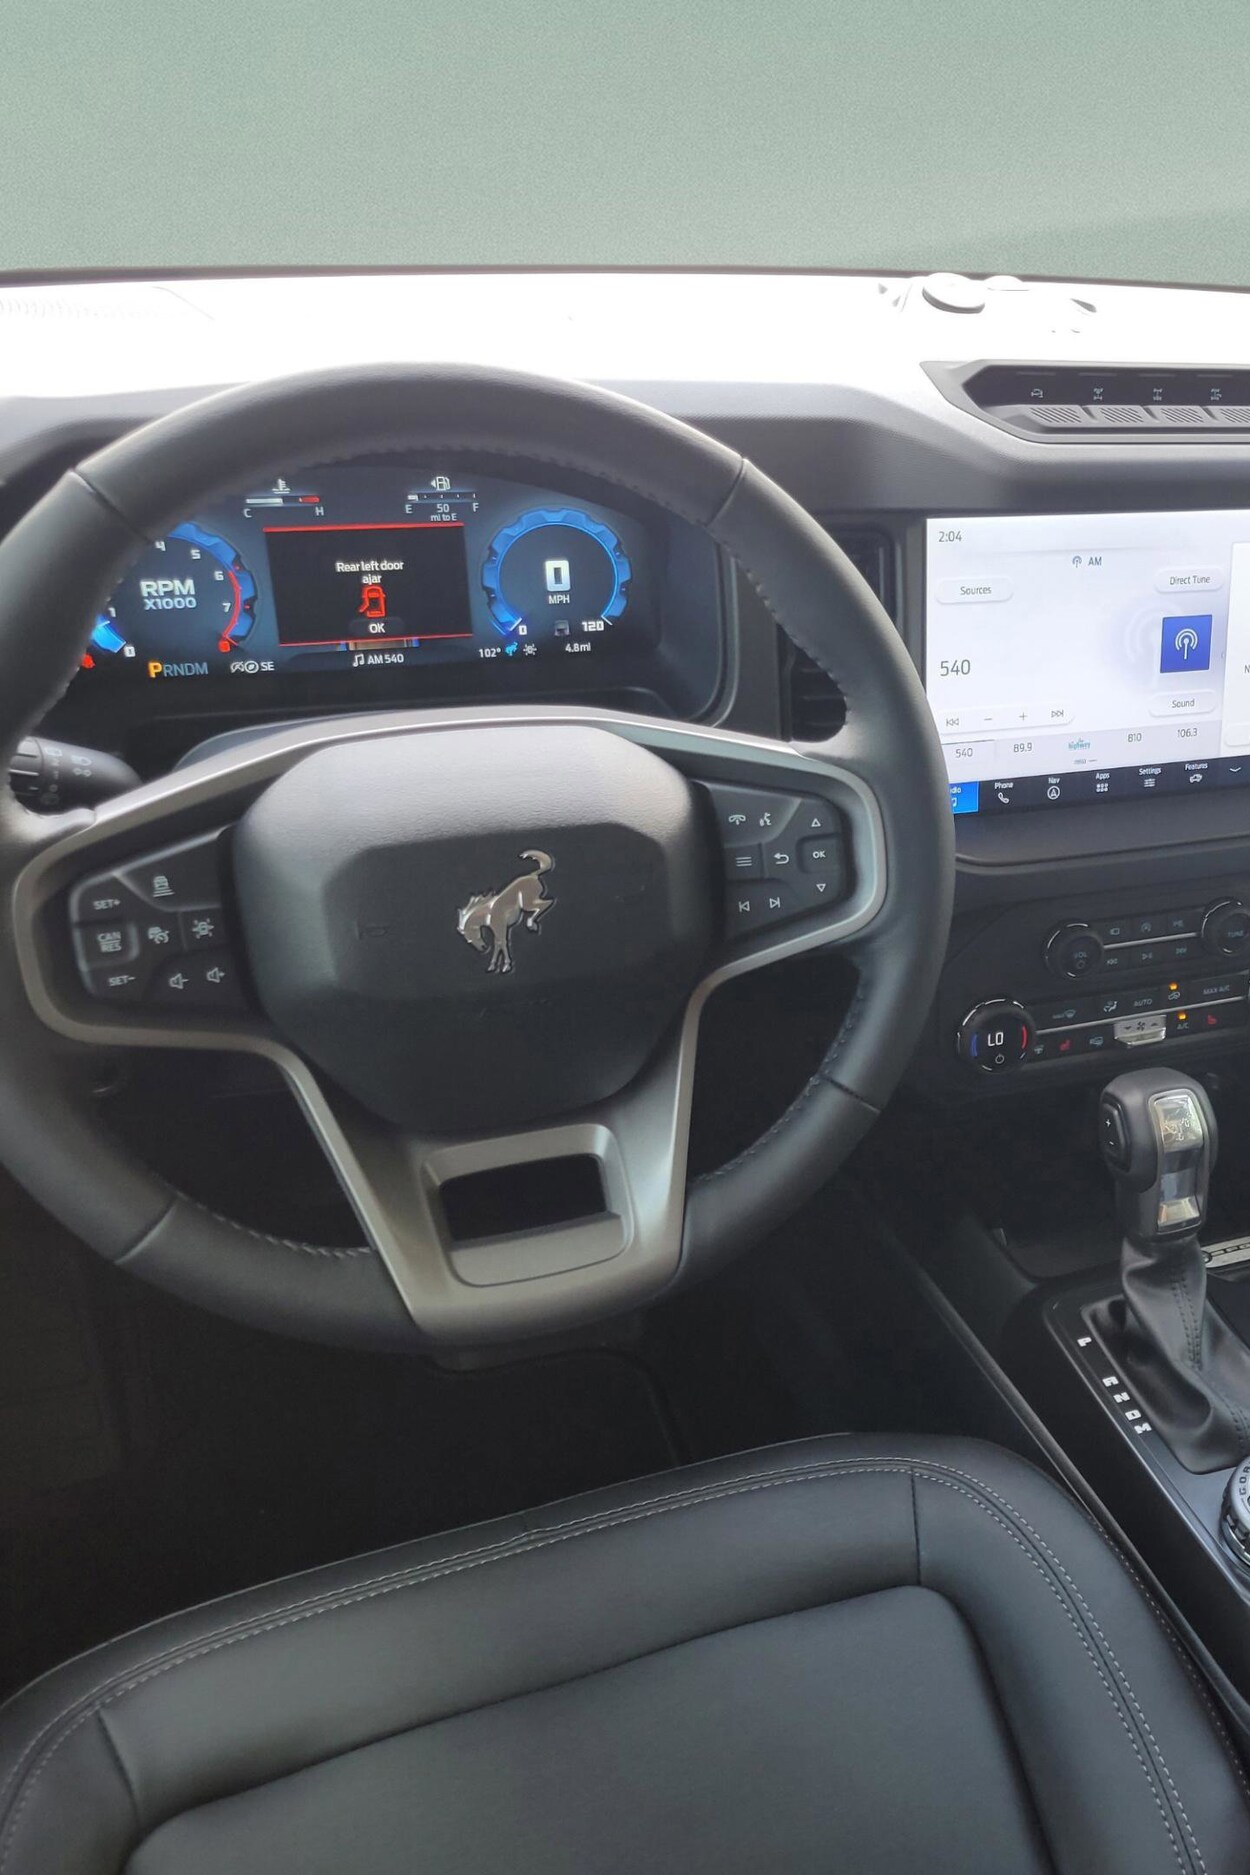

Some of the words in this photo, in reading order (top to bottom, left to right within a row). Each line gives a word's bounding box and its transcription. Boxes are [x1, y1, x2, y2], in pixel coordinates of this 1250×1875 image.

[315, 506, 324, 516] H
[405, 504, 413, 514] E
[436, 503, 450, 513] 50
[472, 503, 480, 512] F
[243, 508, 252, 518] C
[938, 531, 962, 542] 2:04
[155, 541, 166, 551] 4
[190, 549, 201, 560] 5
[336, 561, 360, 572] Rear
[361, 560, 380, 571] left
[380, 560, 404, 571] door
[1088, 557, 1102, 566] AM
[213, 571, 224, 580] 6
[362, 574, 382, 585] ajar
[545, 559, 571, 592] 0
[1170, 576, 1190, 585] Direct
[1193, 575, 1210, 583] Tune
[140, 579, 195, 596] RPM
[960, 585, 992, 595] Sources
[144, 597, 197, 610] X1000
[548, 595, 570, 604] MPH
[223, 602, 231, 612] 7
[369, 623, 385, 633] OK
[518, 625, 528, 635] 0
[581, 621, 604, 632] 120
[367, 654, 384, 665] AM
[384, 653, 404, 664] 540
[261, 662, 275, 671] SE
[940, 659, 971, 677] 540
[1172, 699, 1195, 708] Sound
[1127, 733, 1142, 742] 810
[1177, 728, 1198, 738] 106.3
[1013, 742, 1032, 753] 89.9
[955, 748, 973, 758] 540
[1138, 767, 1162, 776] Settings
[1185, 762, 1208, 771] Features
[1096, 772, 1110, 781] Apps
[994, 781, 1014, 789] Phone
[812, 850, 826, 859] OK
[987, 1031, 1004, 1046] LO
[1077, 1336, 1092, 1347] P
[1113, 1392, 1130, 1403] N
[1125, 1410, 1142, 1421] D
[1134, 1422, 1152, 1434] M
